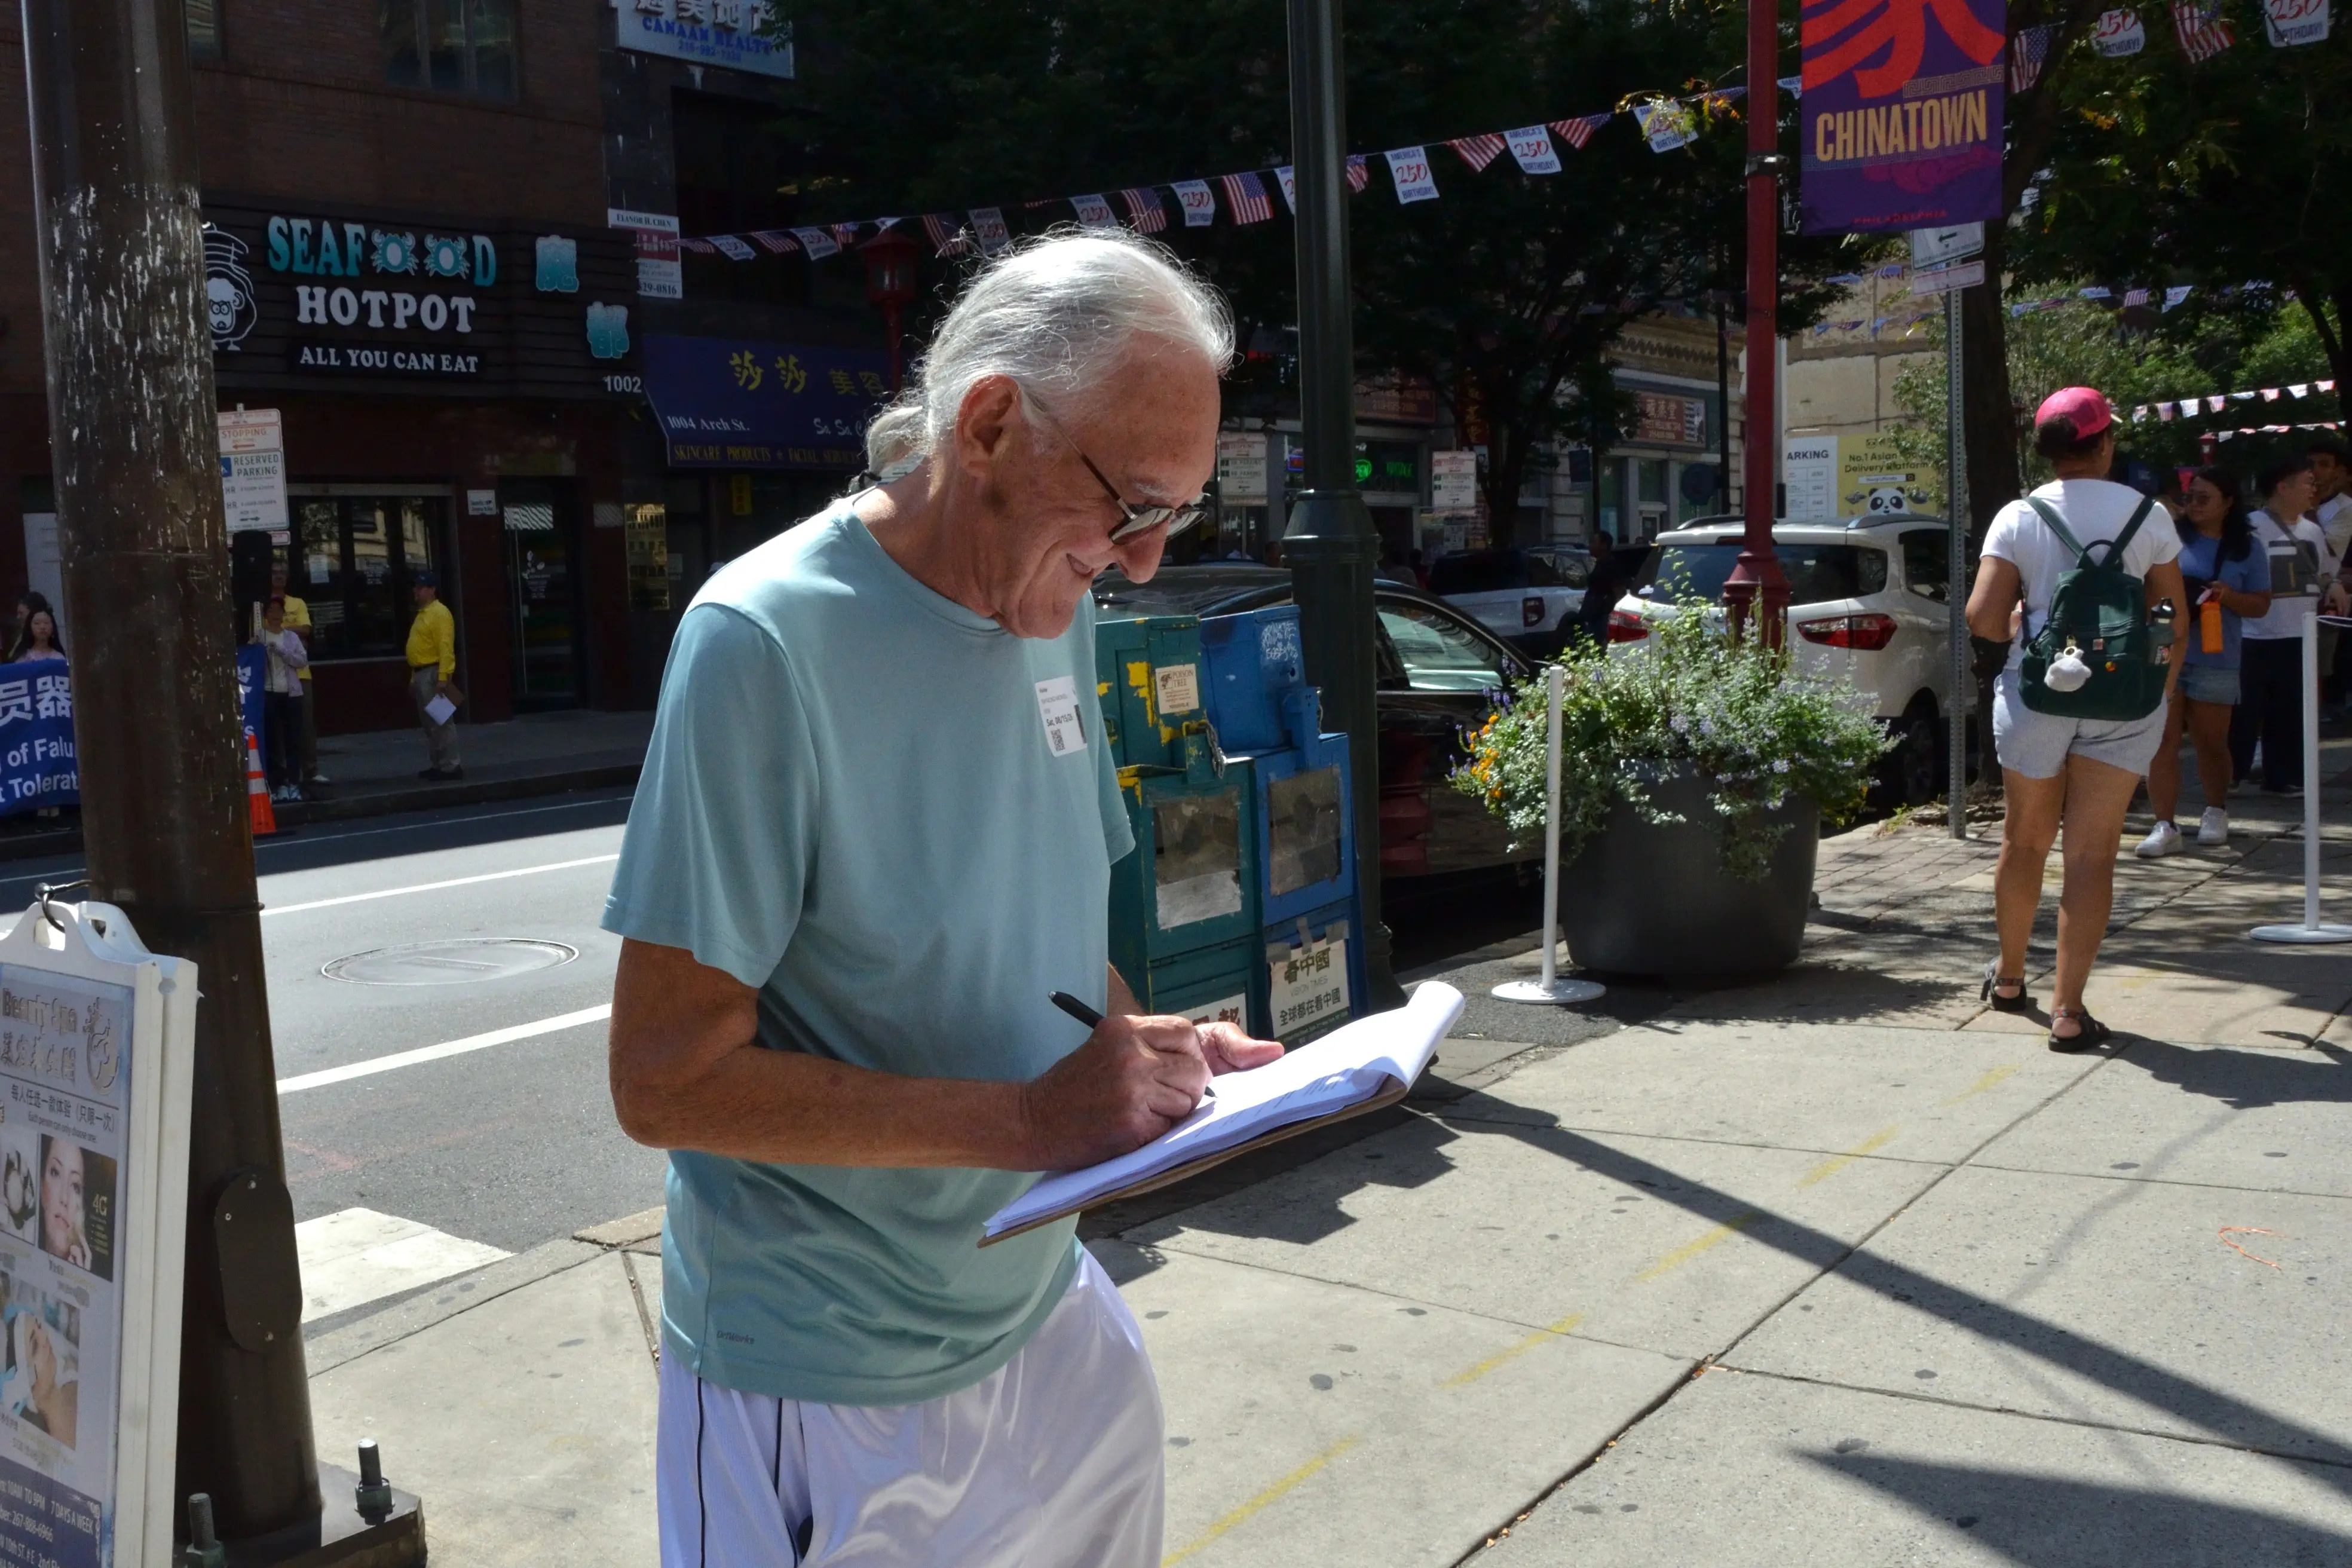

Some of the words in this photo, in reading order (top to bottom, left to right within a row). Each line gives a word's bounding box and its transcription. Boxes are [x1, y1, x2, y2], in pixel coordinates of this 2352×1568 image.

[642, 16, 709, 42] CANAAN
[1815, 90, 1987, 162] CHINATOWN
[1514, 140, 1549, 158] 250
[1395, 163, 1428, 184] 250
[1523, 160, 1557, 171] BIRTHDAY!
[1182, 190, 1210, 207] 250
[1401, 185, 1434, 200] BIRTHDAY!
[1080, 204, 1108, 222] 250
[296, 285, 476, 333] HOTPOT
[300, 346, 341, 366] ALL
[346, 349, 388, 369] YOU
[393, 351, 435, 372] CAN
[440, 354, 479, 373] EAT
[604, 375, 642, 394] 1002
[667, 415, 696, 431] 1004
[700, 418, 729, 432] Arch
[731, 419, 751, 433] St.
[221, 428, 267, 439] STOPPING
[234, 454, 279, 466] RESERVED
[673, 445, 721, 461] SKINCARE
[725, 446, 771, 462] PRODUCTS
[787, 448, 819, 464] FACIAL
[1787, 449, 1829, 461] ARKING
[1848, 453, 1869, 463] No.1
[1870, 452, 1898, 462] Asian
[237, 466, 278, 477] PARKING
[1845, 463, 1884, 473] Delivery
[7, 742, 29, 767] of
[34, 736, 76, 761] Falu
[8, 771, 79, 799] Tolerat
[1291, 982, 1309, 997] VISION
[1310, 975, 1328, 988] TIMES
[1279, 987, 1341, 1027] 全球都在看中國
